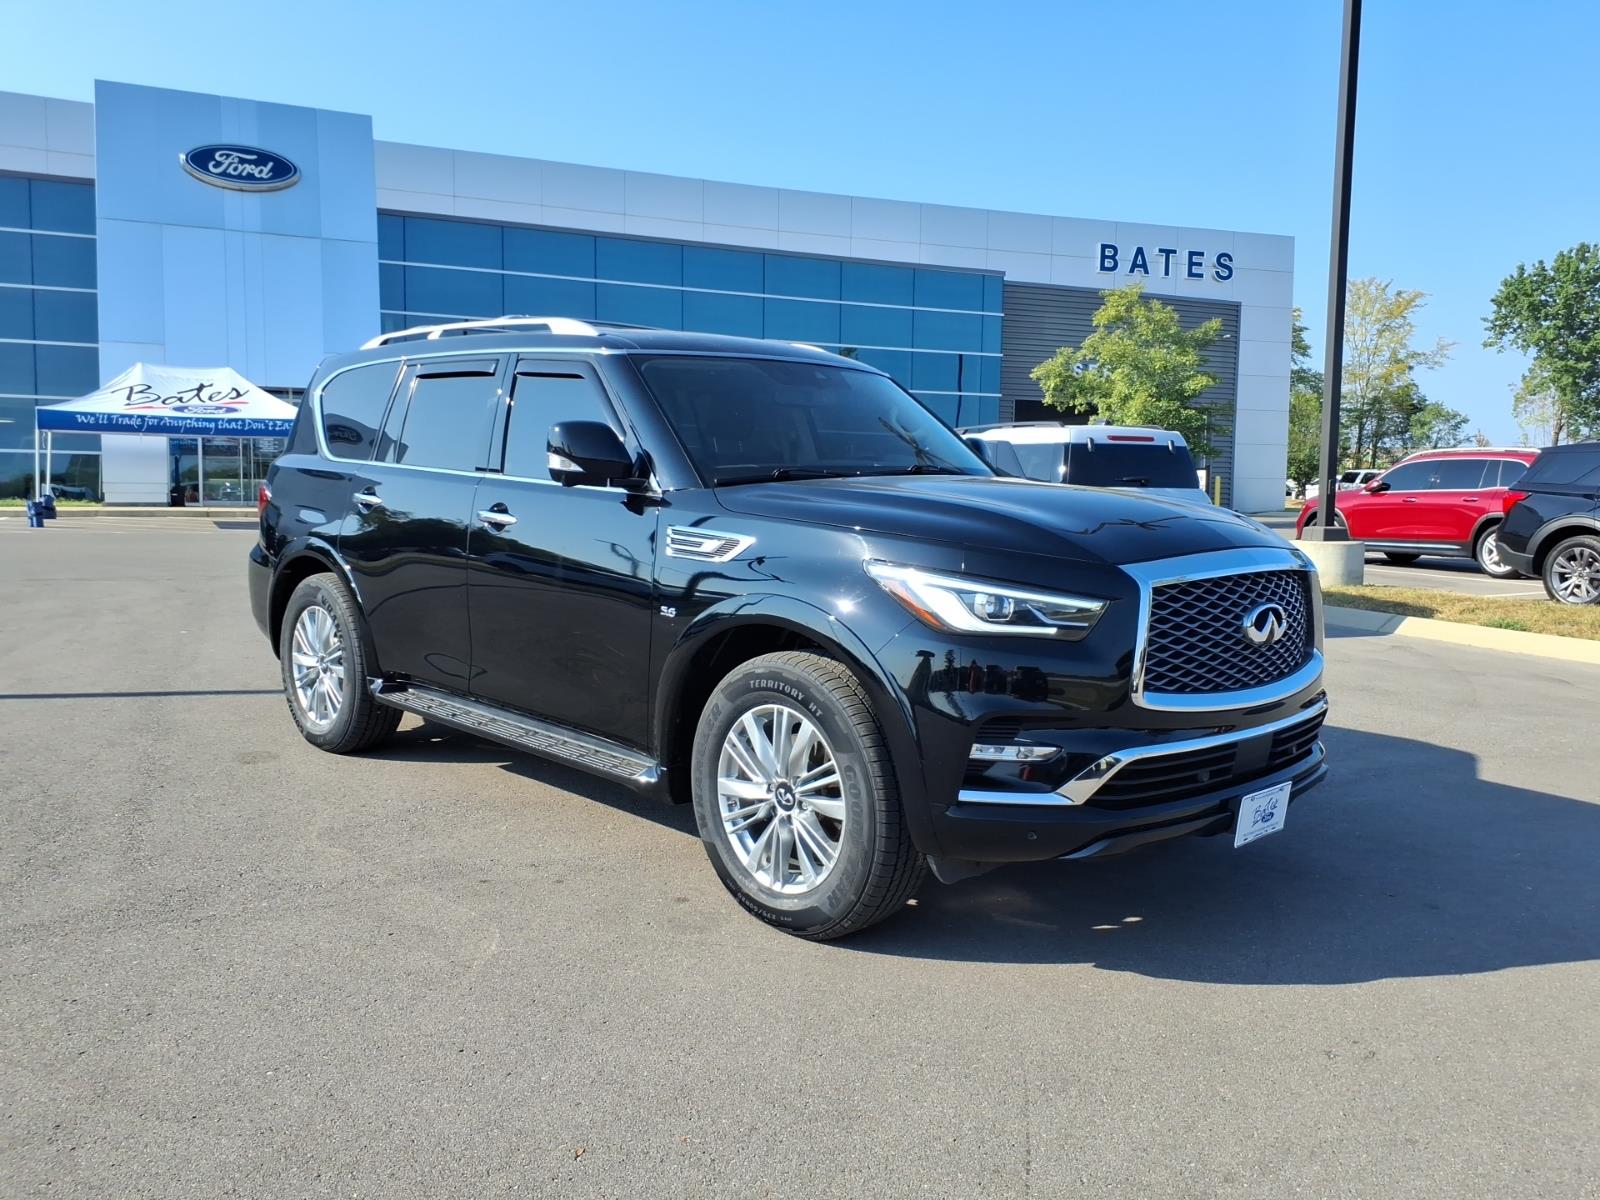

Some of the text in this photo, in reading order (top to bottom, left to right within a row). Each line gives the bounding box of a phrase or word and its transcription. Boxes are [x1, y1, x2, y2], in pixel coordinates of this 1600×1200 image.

[208, 150, 274, 179] Ford
[1099, 242, 1234, 281] BATES
[111, 383, 249, 406] Bates
[75, 413, 108, 424] We'll
[111, 414, 142, 428] Trade
[142, 415, 158, 431] for
[160, 417, 215, 434] Anything
[218, 418, 243, 430] that
[244, 418, 274, 430] Don't
[749, 679, 824, 717] TERRITORY HT
